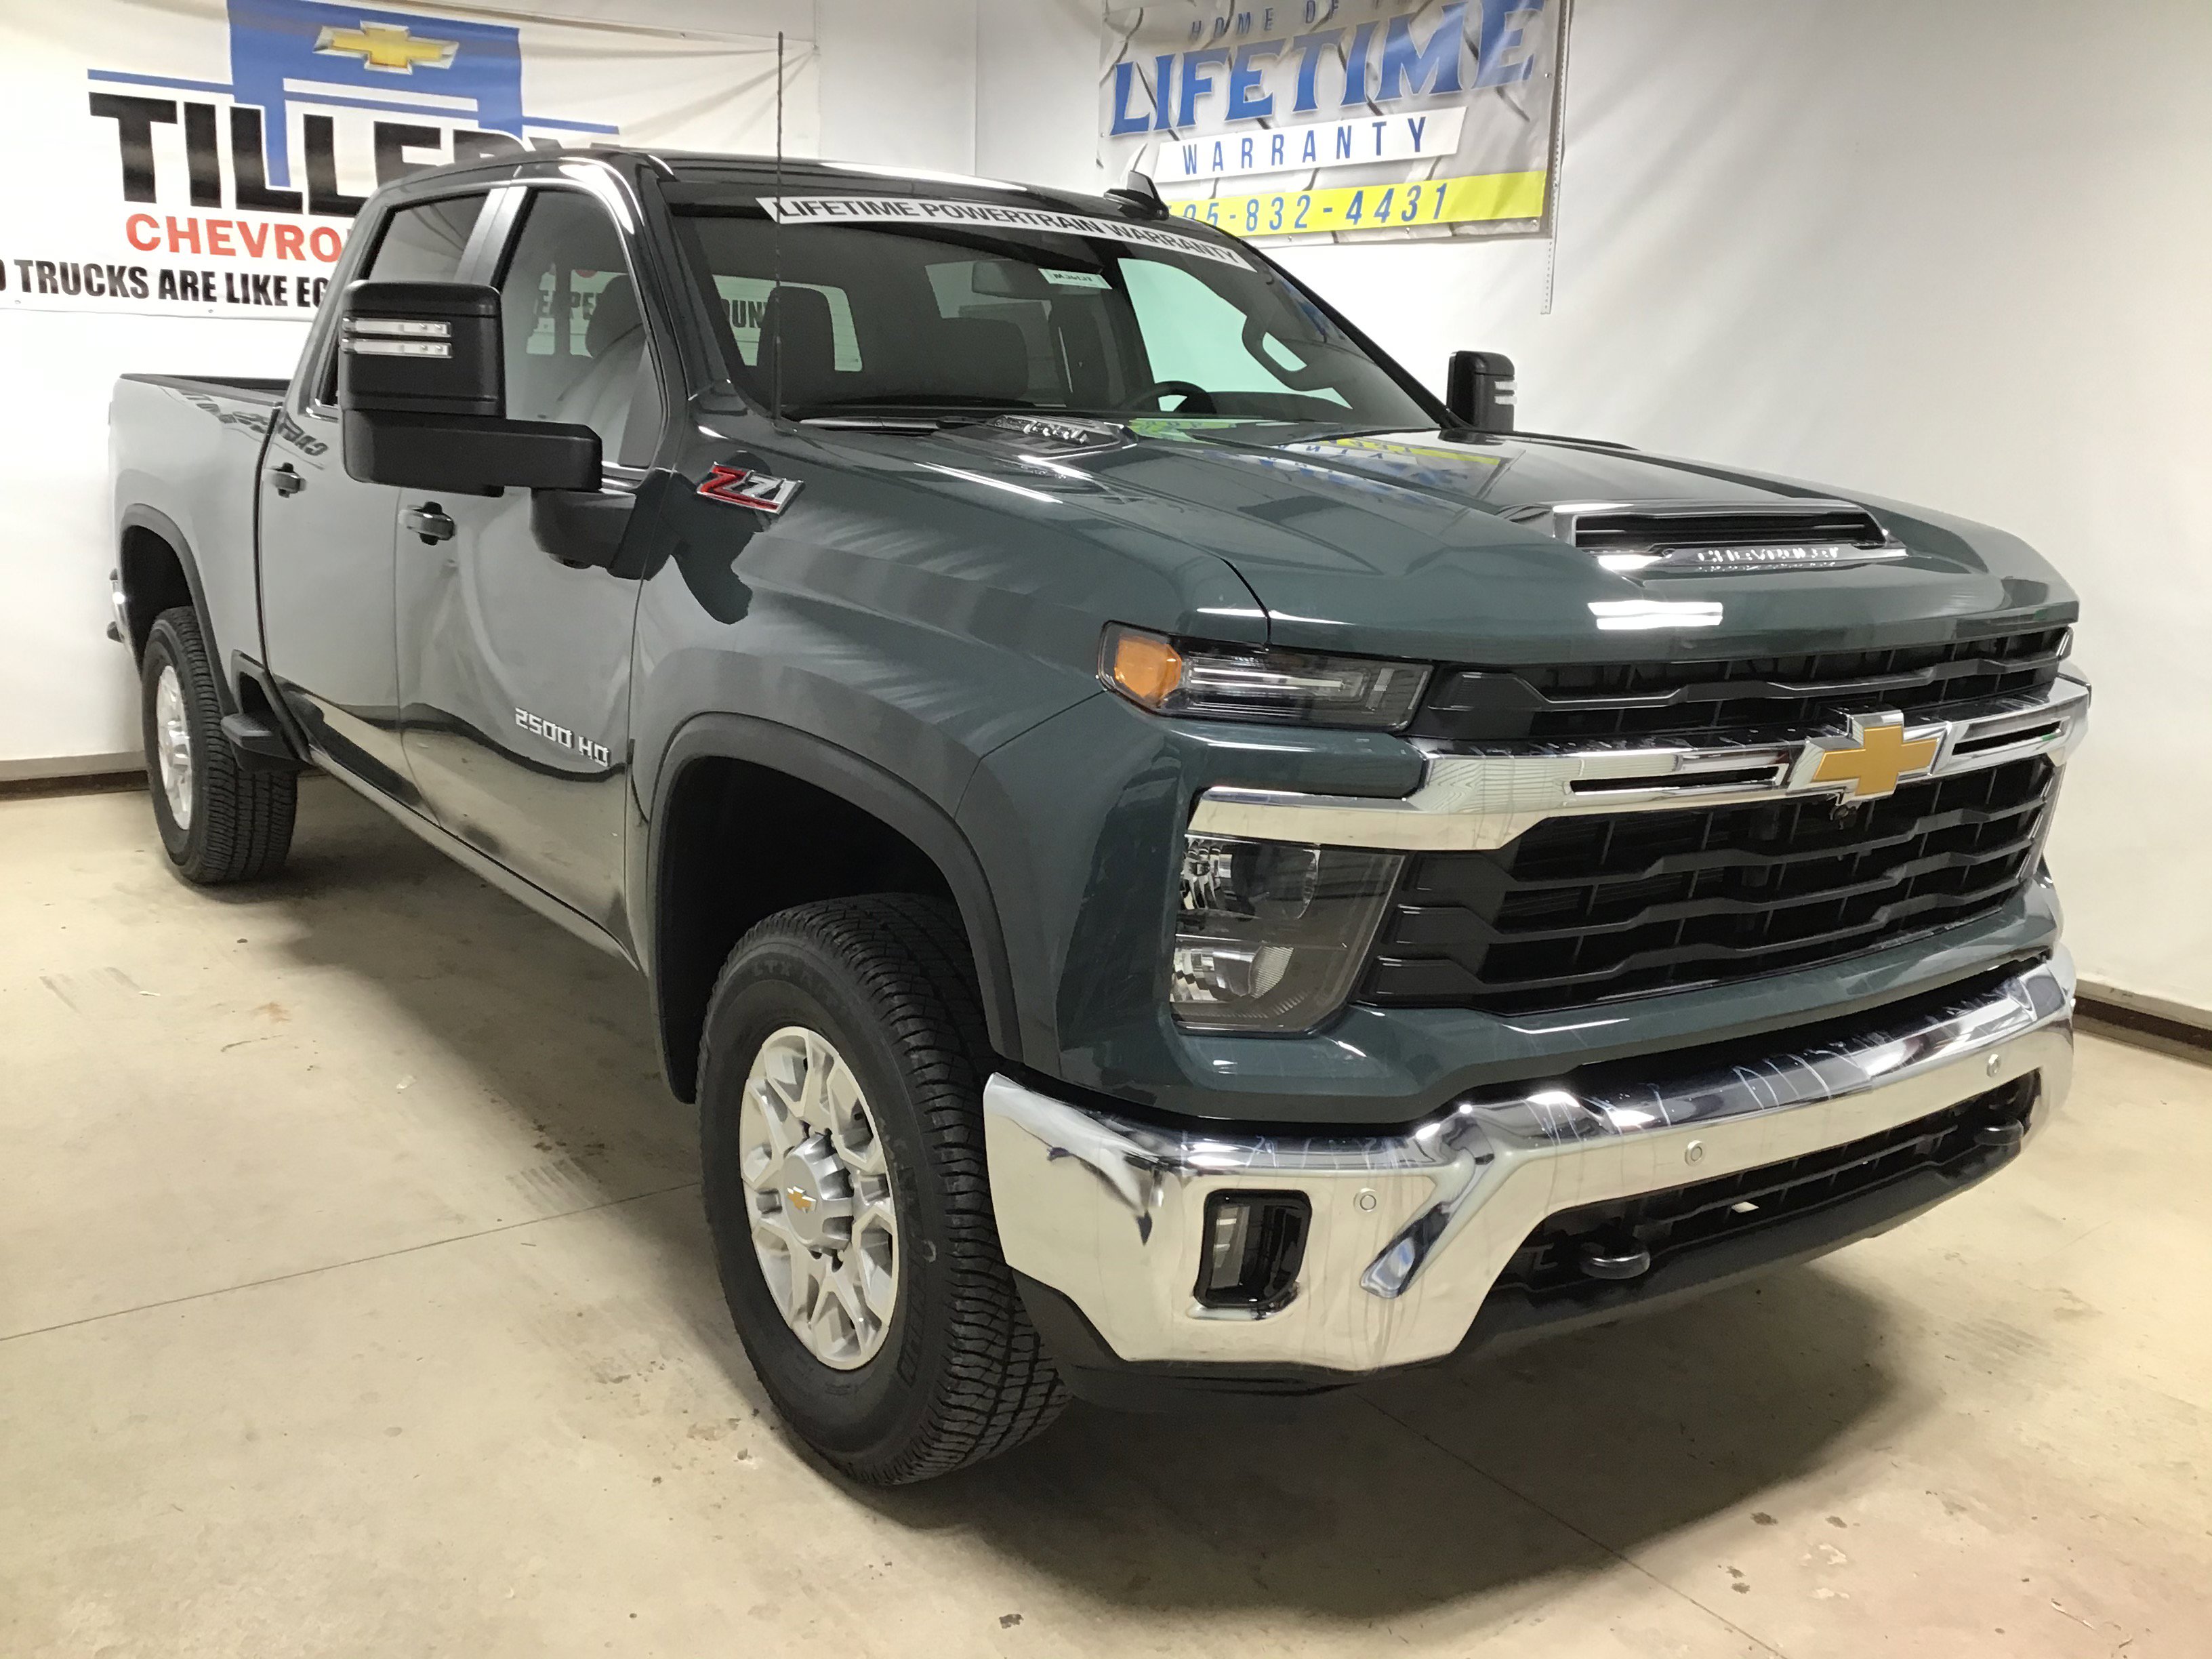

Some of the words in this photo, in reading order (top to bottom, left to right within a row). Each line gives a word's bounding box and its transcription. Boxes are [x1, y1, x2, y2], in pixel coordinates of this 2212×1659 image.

[1189, 7, 1273, 41] HOME
[1305, 0, 1339, 24] OF
[1111, 0, 1544, 136] LIFETIME
[89, 92, 648, 216] TILLE
[1183, 117, 1427, 176] WARRANTY
[125, 213, 352, 263] CHEVRO
[772, 200, 920, 217] LIFETIME
[919, 203, 1107, 234] POWERTRAIN
[1107, 222, 1240, 264] WARRANTY
[14, 259, 150, 299] TRUCKS
[158, 268, 217, 302] ARE
[225, 272, 289, 307] LIKE
[696, 461, 804, 515] Z71
[515, 707, 573, 750] 2500
[578, 735, 611, 768] HD
